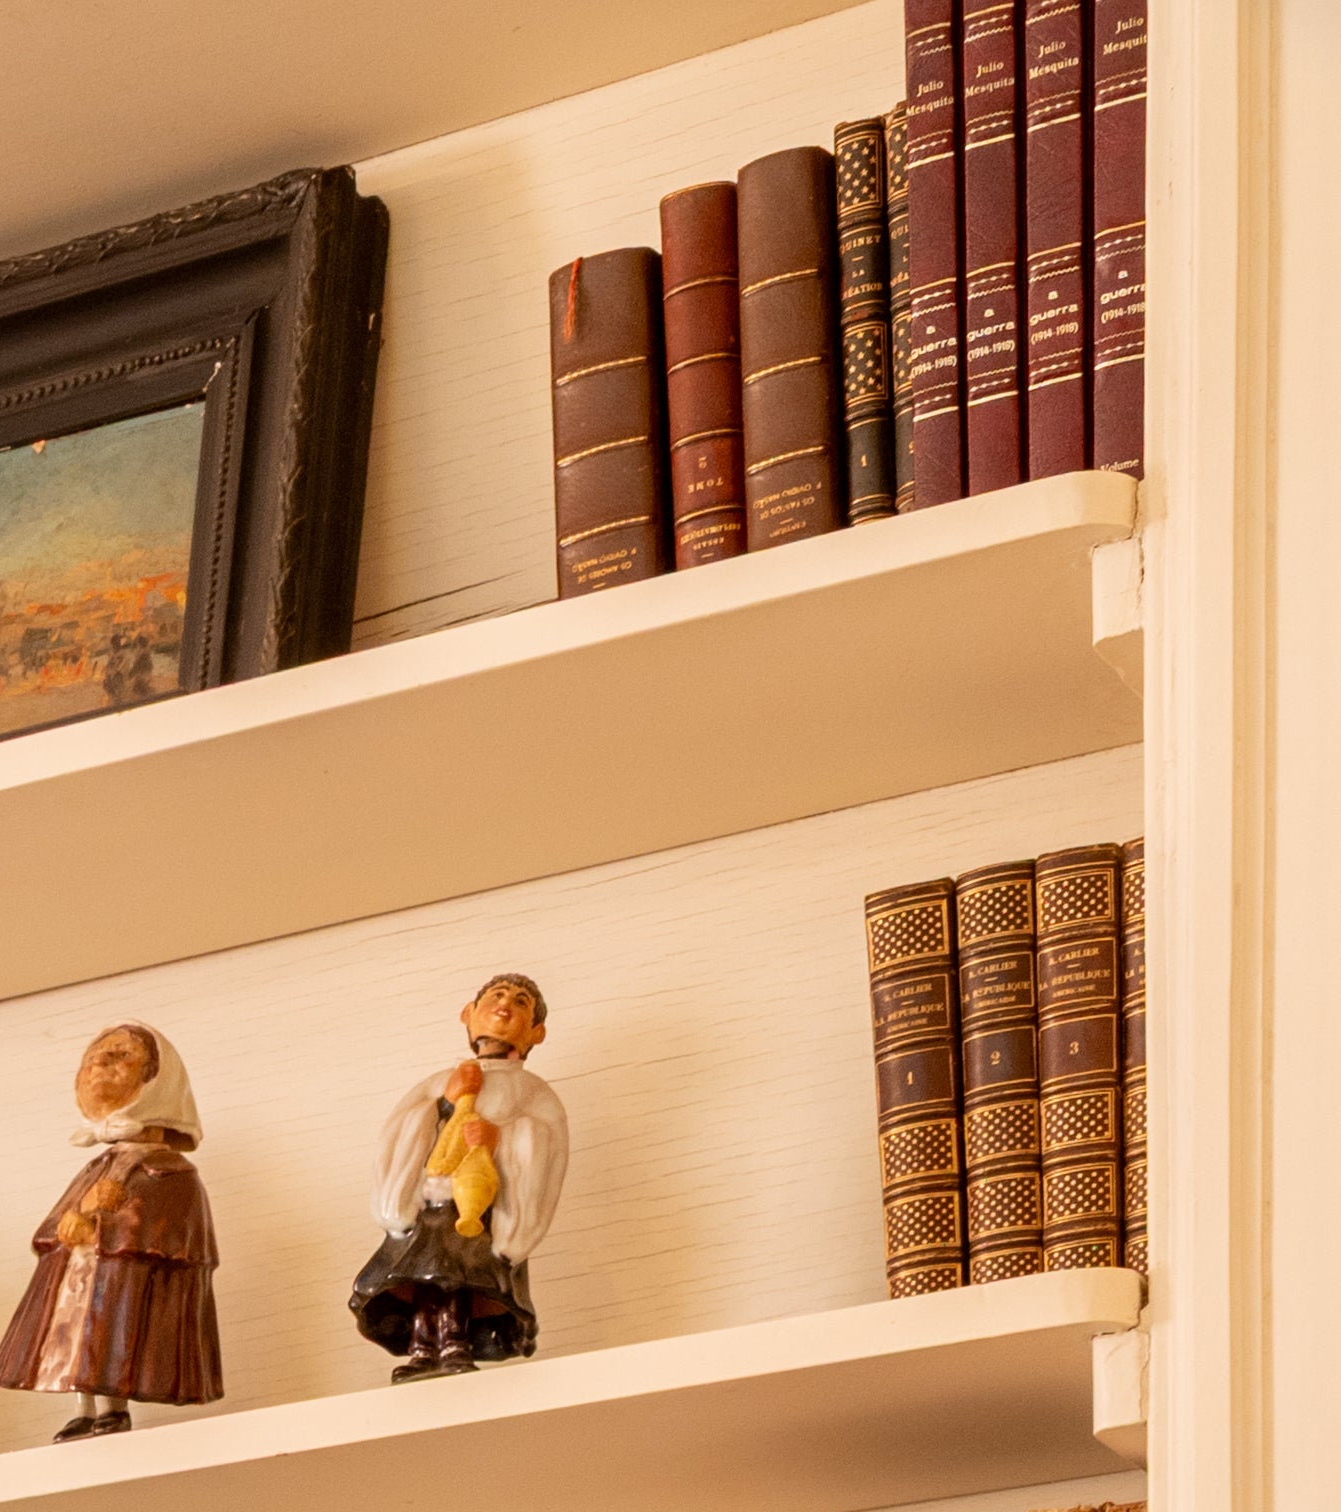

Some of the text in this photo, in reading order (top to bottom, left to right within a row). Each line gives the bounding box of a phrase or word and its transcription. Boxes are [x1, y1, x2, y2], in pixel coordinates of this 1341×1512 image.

[1116, 17, 1144, 34] Julio
[1038, 40, 1066, 58] Julio
[1103, 35, 1147, 56] Mesquit
[976, 61, 1004, 78] Julio
[1029, 56, 1079, 80] Mesquita
[917, 81, 944, 97] Julio
[966, 77, 1015, 98] Mesquita
[906, 95, 954, 117] Mesquita
[1118, 270, 1128, 279] a
[1048, 291, 1058, 301] a
[984, 308, 994, 318] a
[1029, 303, 1078, 326] guerra
[1101, 302, 1145, 324] (1914-1918
[926, 325, 936, 335] a
[967, 321, 1015, 343] guerra
[911, 337, 957, 360] guerra
[687, 478, 724, 494] TOME
[1058, 947, 1099, 964] CARLIER
[977, 961, 1018, 977] CARLIER
[893, 983, 933, 1000] CARLIER
[1069, 1041, 1079, 1055] 3
[990, 1051, 1000, 1066] 2
[906, 1070, 914, 1086] 1
